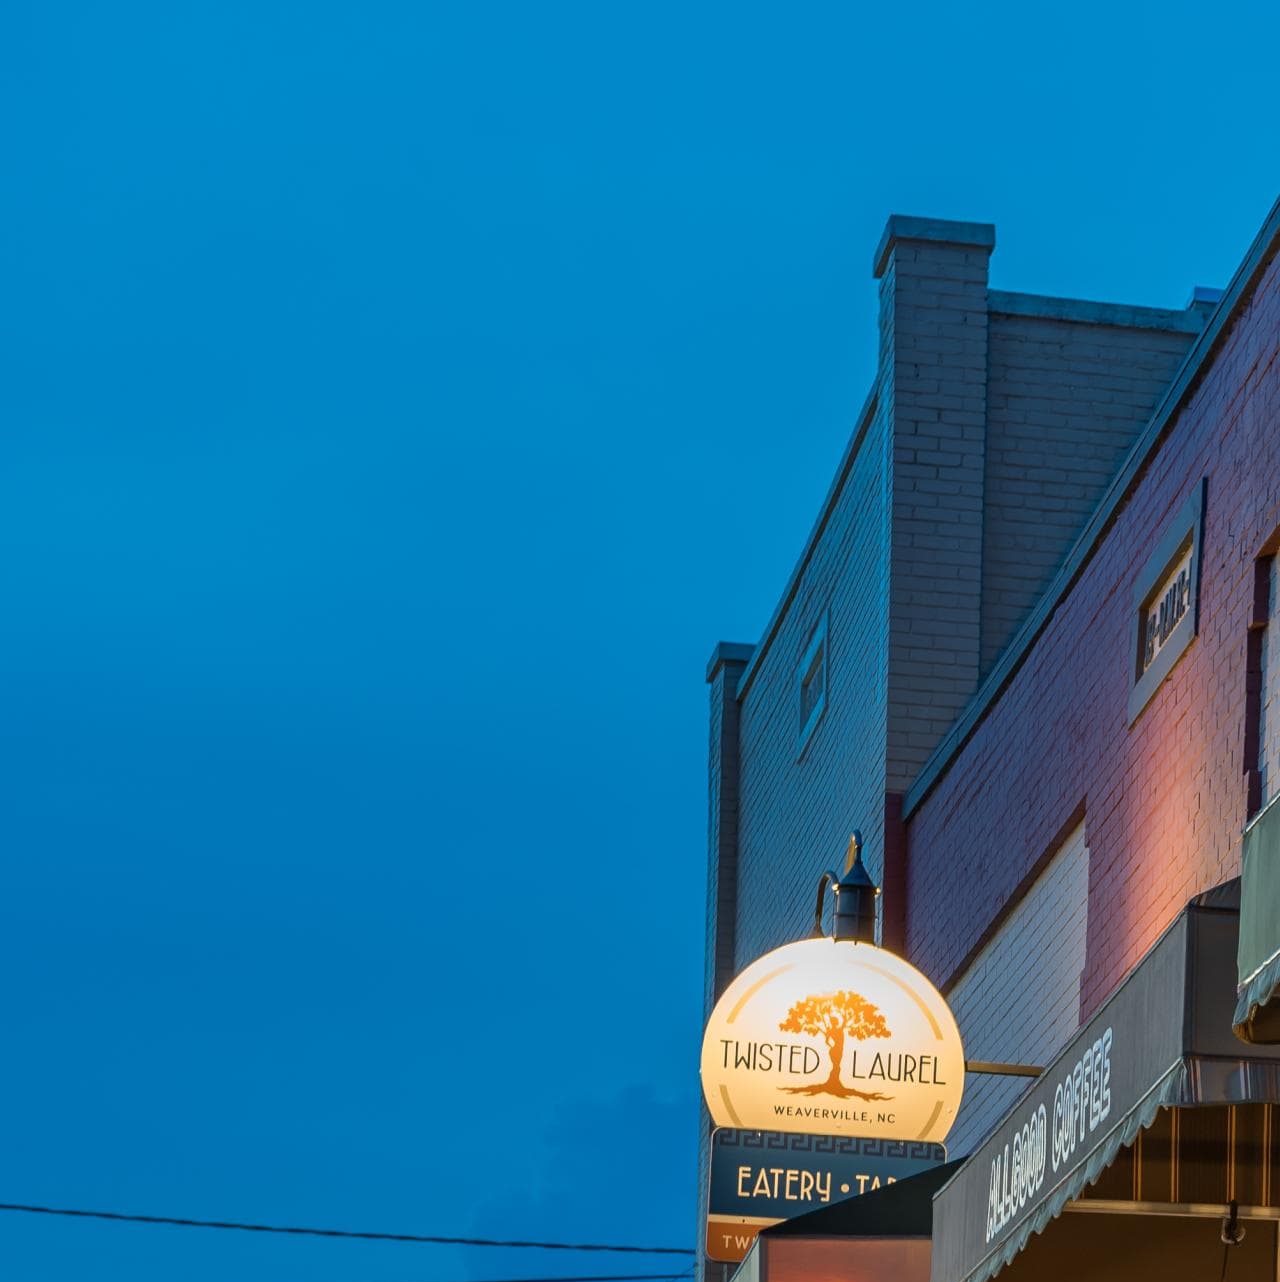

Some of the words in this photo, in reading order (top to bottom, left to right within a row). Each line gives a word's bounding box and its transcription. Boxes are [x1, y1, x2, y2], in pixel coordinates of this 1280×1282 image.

[720, 1040, 820, 1075] TWISTED
[853, 1050, 946, 1085] LAUREL
[774, 1105, 873, 1123] WEAVERVILLE,
[877, 1112, 896, 1124] NC
[986, 1103, 1047, 1243] ALLGOOD
[1052, 1027, 1113, 1173] COFFEE
[737, 1166, 832, 1202] EATERY
